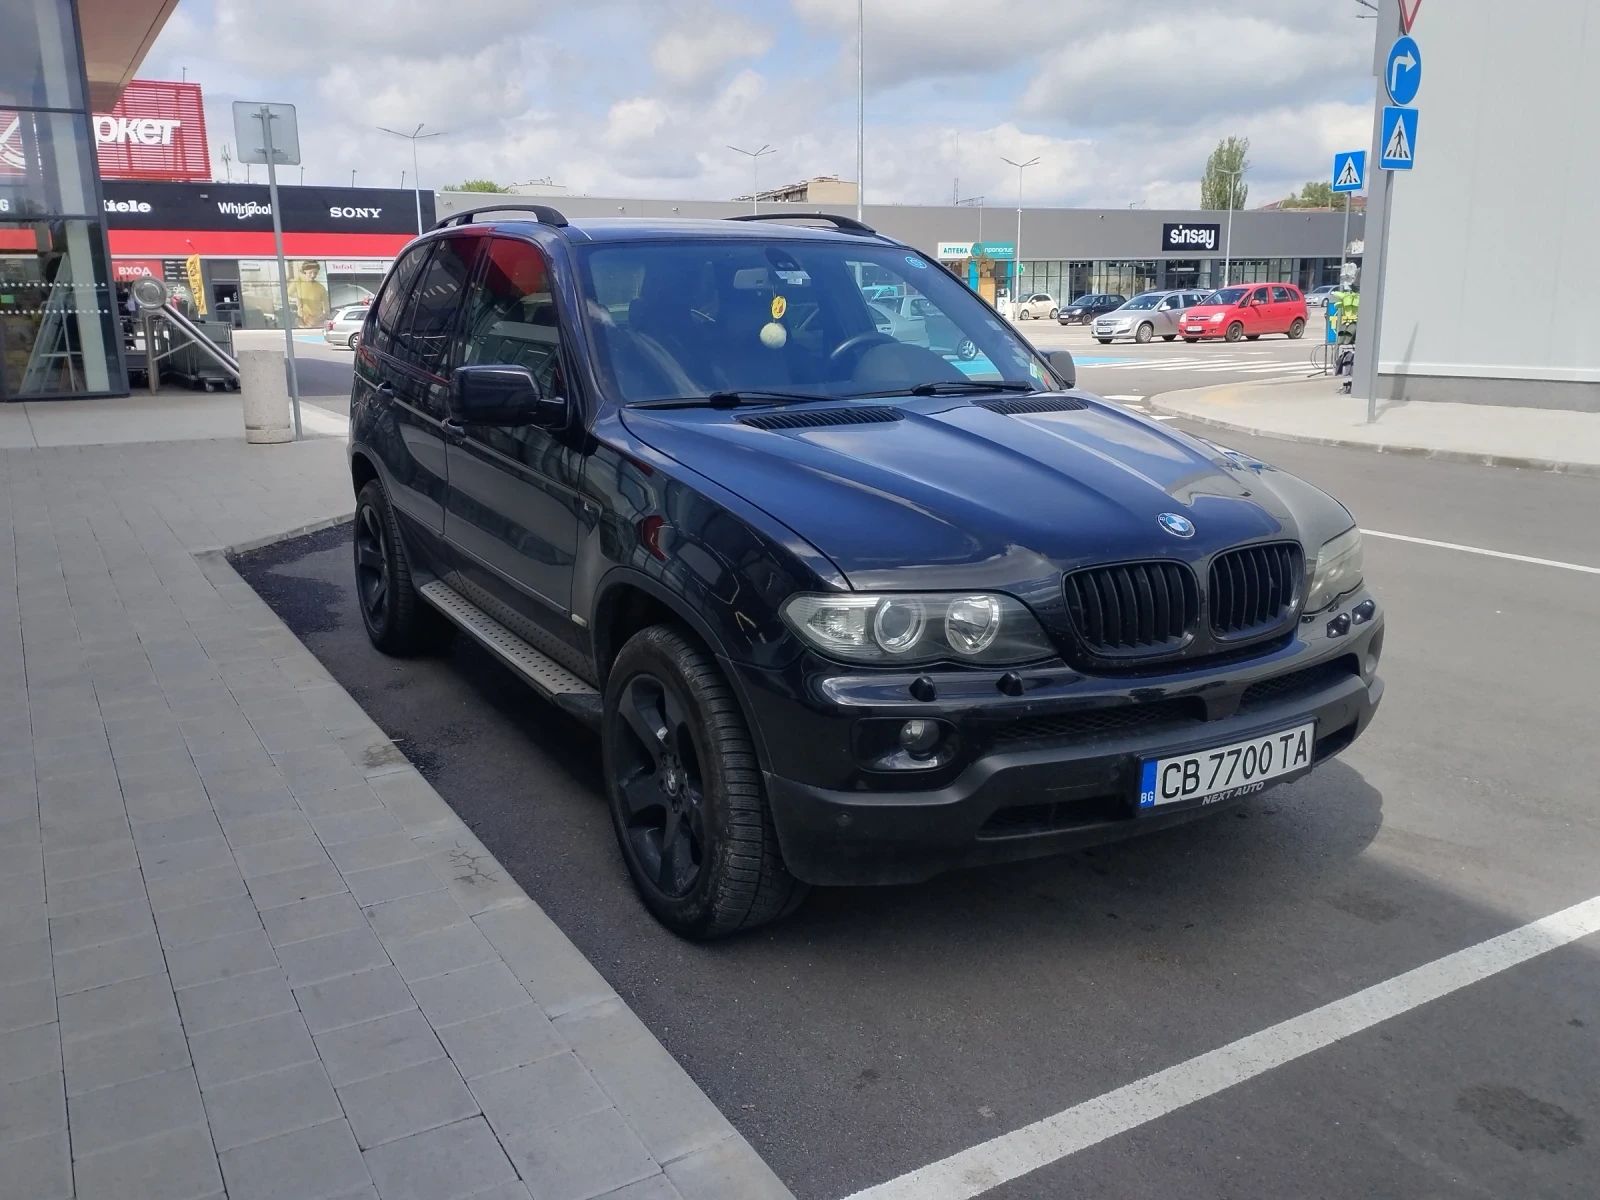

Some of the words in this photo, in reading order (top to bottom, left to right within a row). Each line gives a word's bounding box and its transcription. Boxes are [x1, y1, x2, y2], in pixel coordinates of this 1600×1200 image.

[103, 200, 151, 213] iele
[217, 201, 272, 219] Whirlpool
[329, 206, 382, 218] SONY
[1169, 224, 1215, 249] sinsay
[117, 266, 152, 277] ВХОД
[1161, 758, 1200, 799] CB
[1206, 740, 1273, 790] 7700
[1279, 730, 1307, 771] TA
[1140, 791, 1154, 804] BG
[1201, 789, 1234, 806] NEXT
[1234, 781, 1265, 797] AUTO
